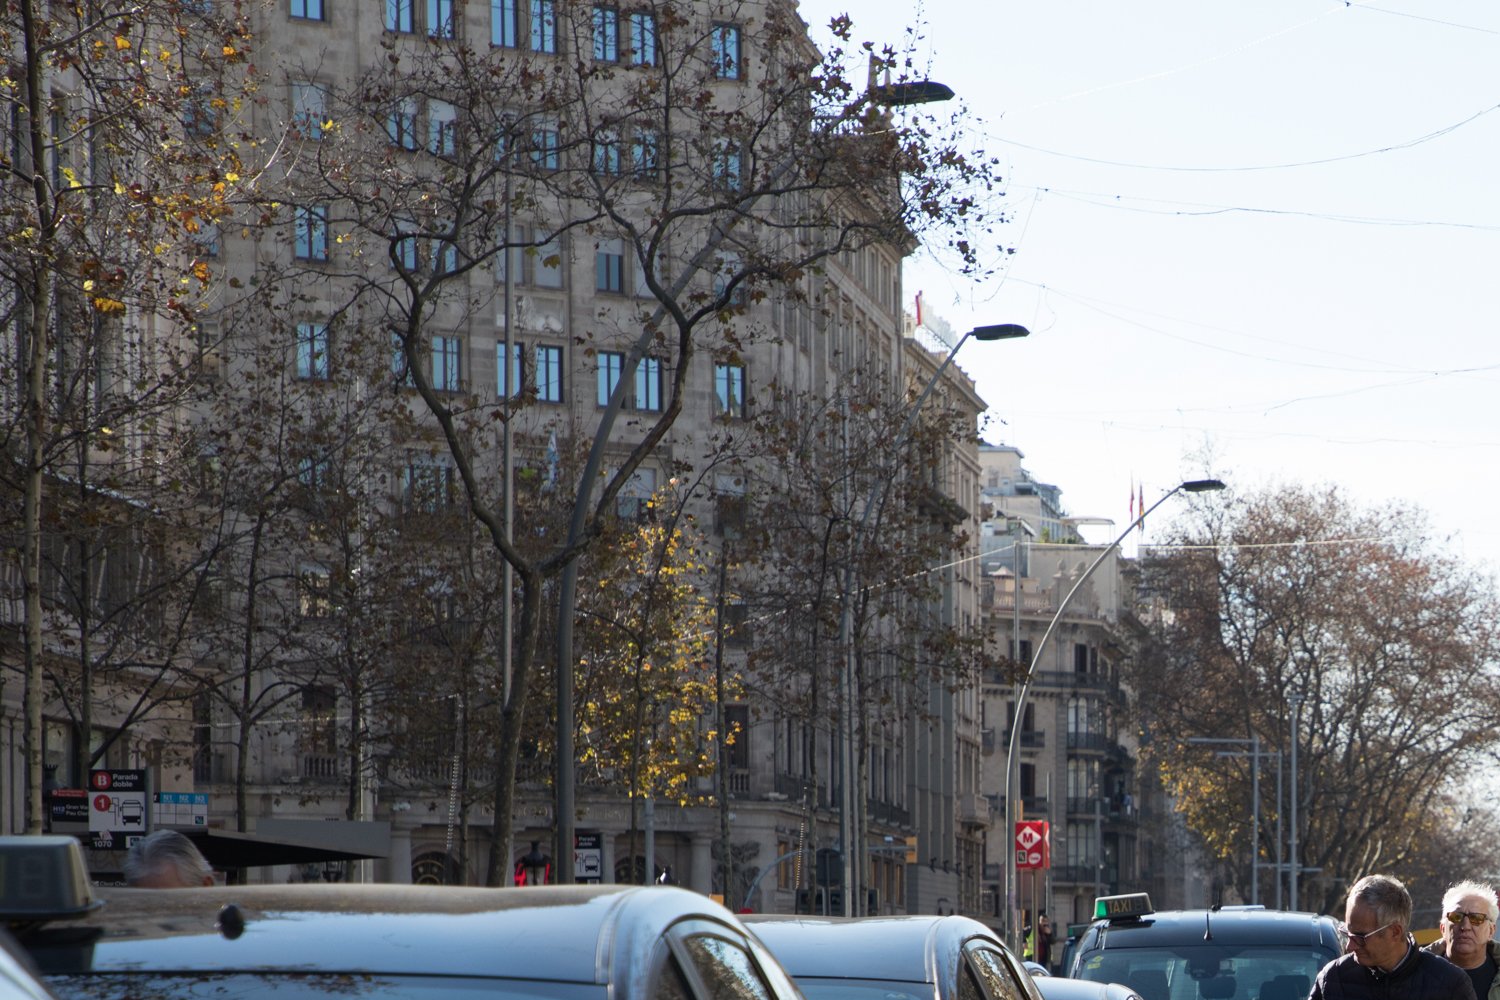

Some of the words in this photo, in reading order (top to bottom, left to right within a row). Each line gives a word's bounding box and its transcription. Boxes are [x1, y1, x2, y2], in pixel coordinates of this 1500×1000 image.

[98, 775, 107, 786] B
[1023, 832, 1033, 843] M
[94, 840, 112, 848] 1070
[1107, 898, 1131, 913] TAXI
